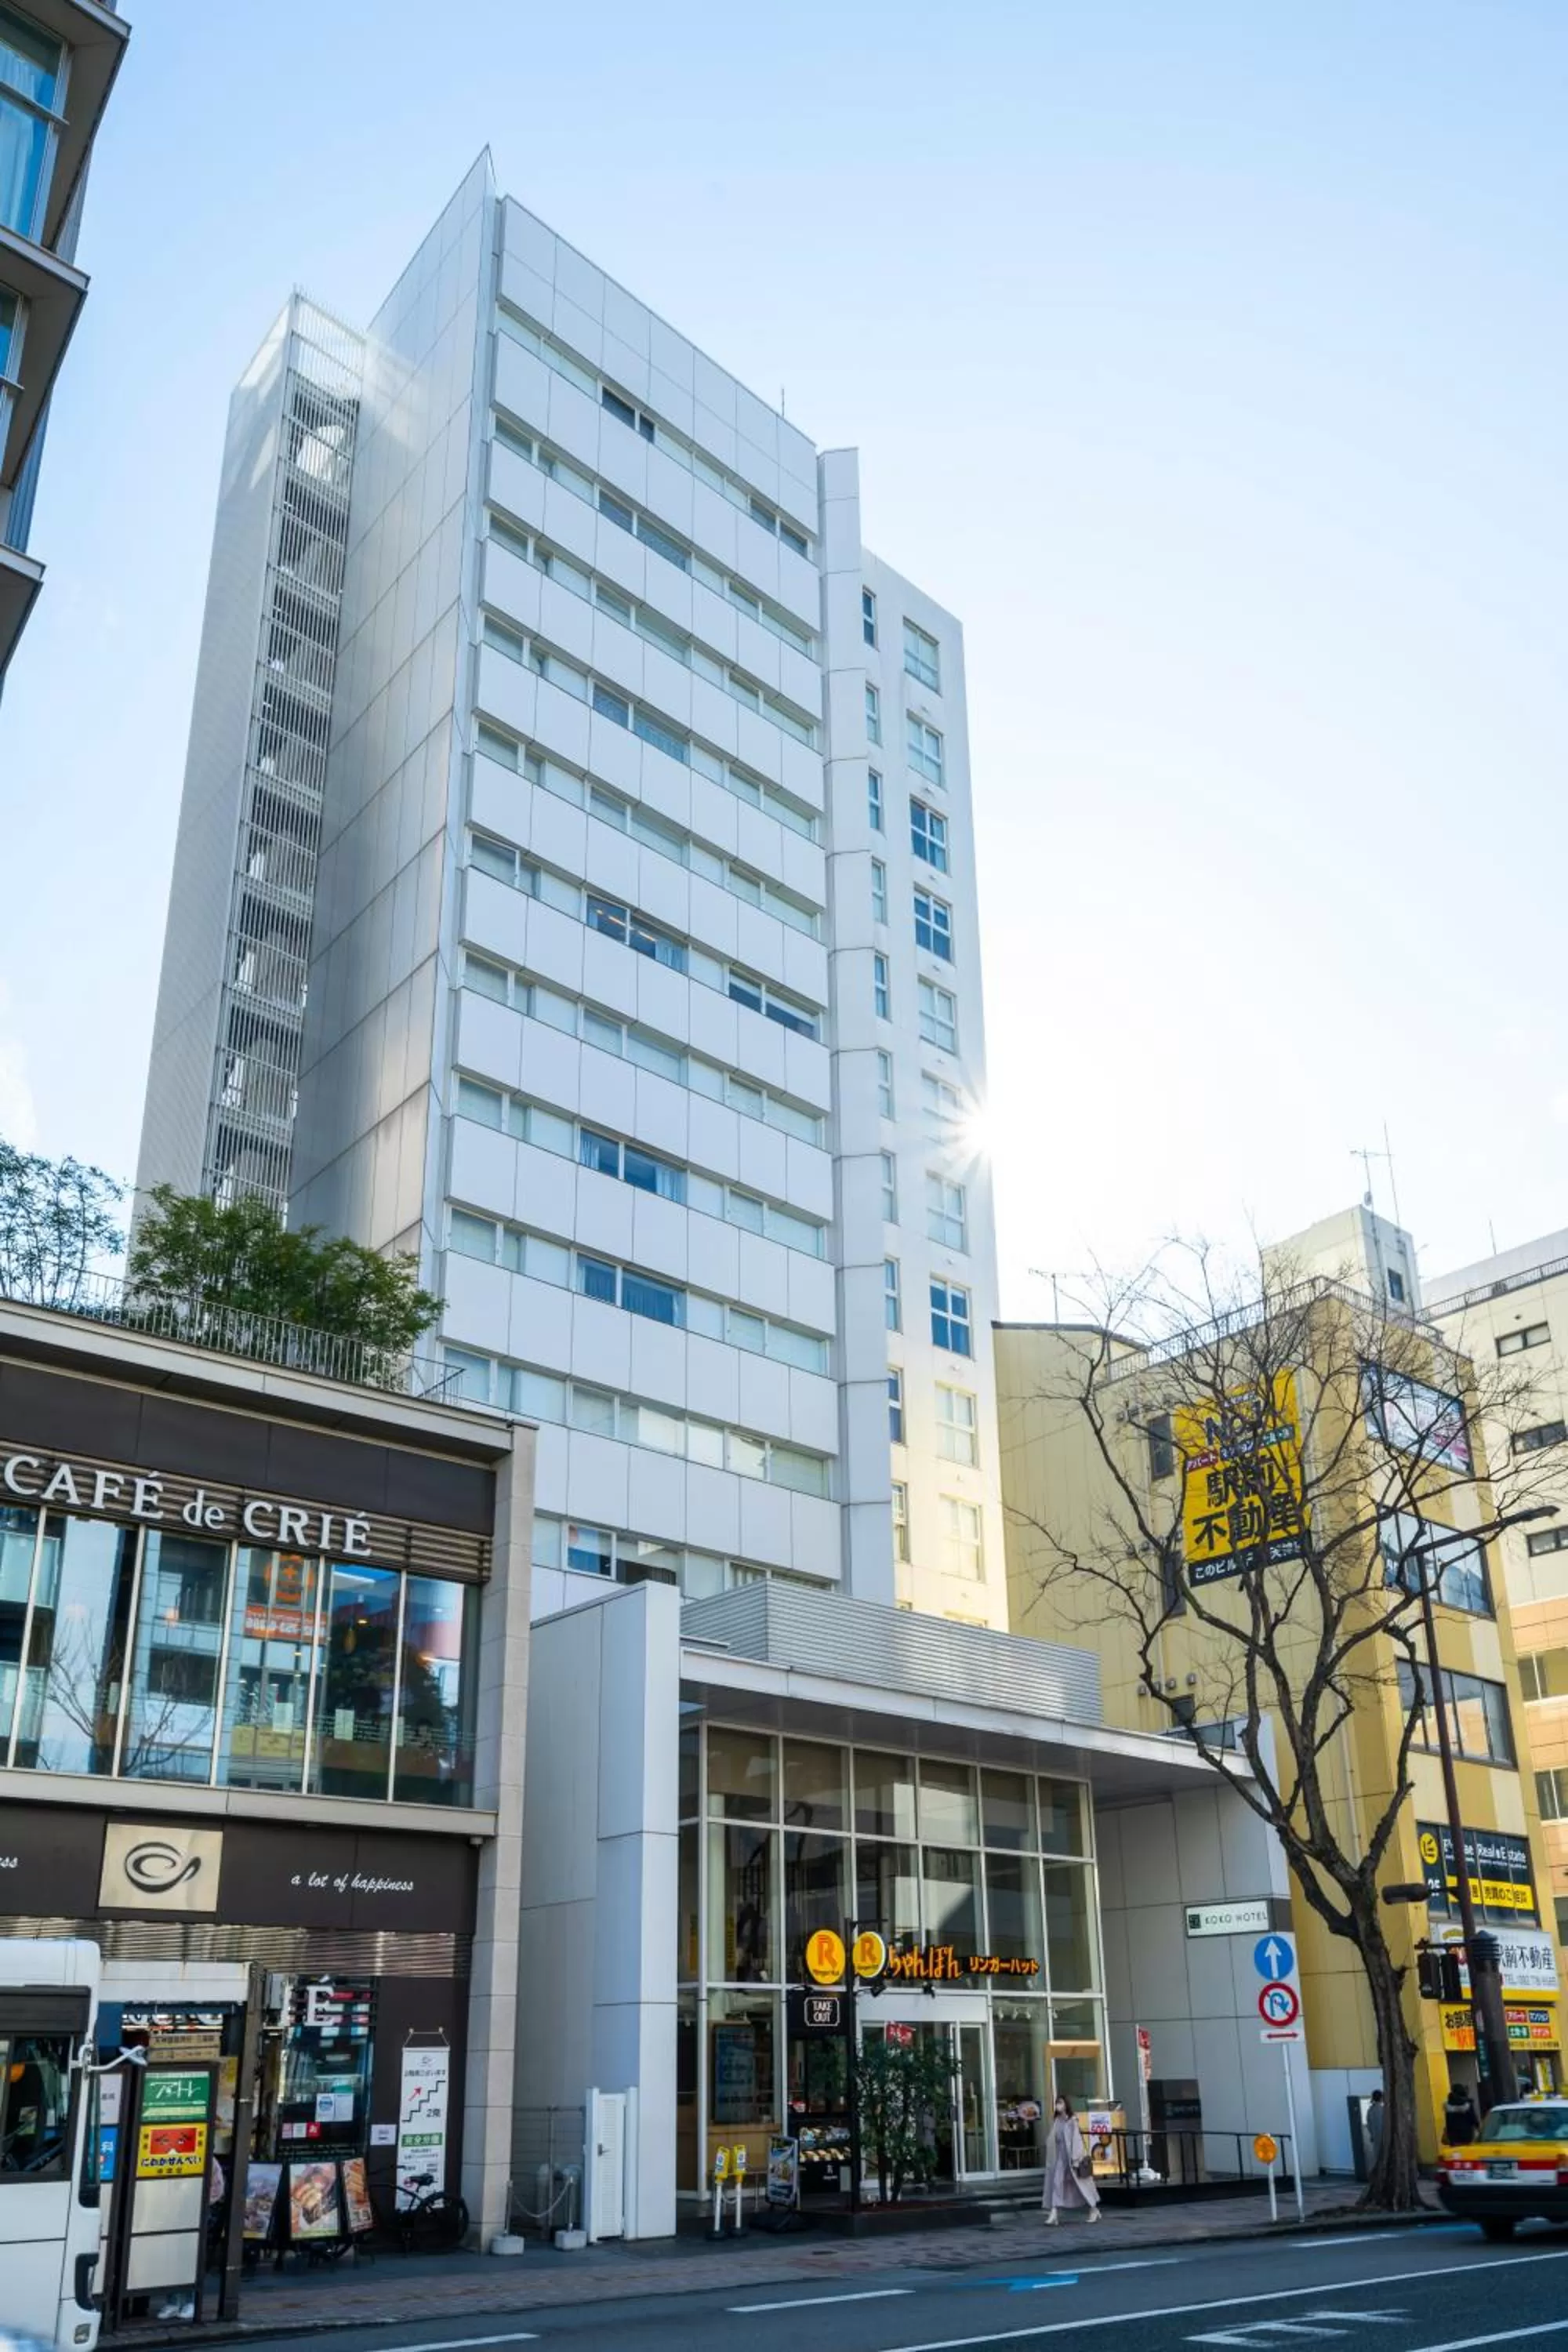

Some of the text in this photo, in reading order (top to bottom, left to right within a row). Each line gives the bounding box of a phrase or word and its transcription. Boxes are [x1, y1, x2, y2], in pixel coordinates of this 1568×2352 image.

[4, 1454, 372, 1556] CAFÉ de CRIÉ
[1192, 1493, 1300, 1551] 不動産
[308, 1871, 328, 1887] lot
[333, 1873, 349, 1893] of
[350, 1872, 414, 1893] happiness
[1205, 1911, 1268, 1925] KOKO HOTEL
[969, 1956, 1040, 1976] リンガーハット
[812, 2000, 832, 2011] TAKE
[141, 2157, 201, 2167] にわかせんべい
